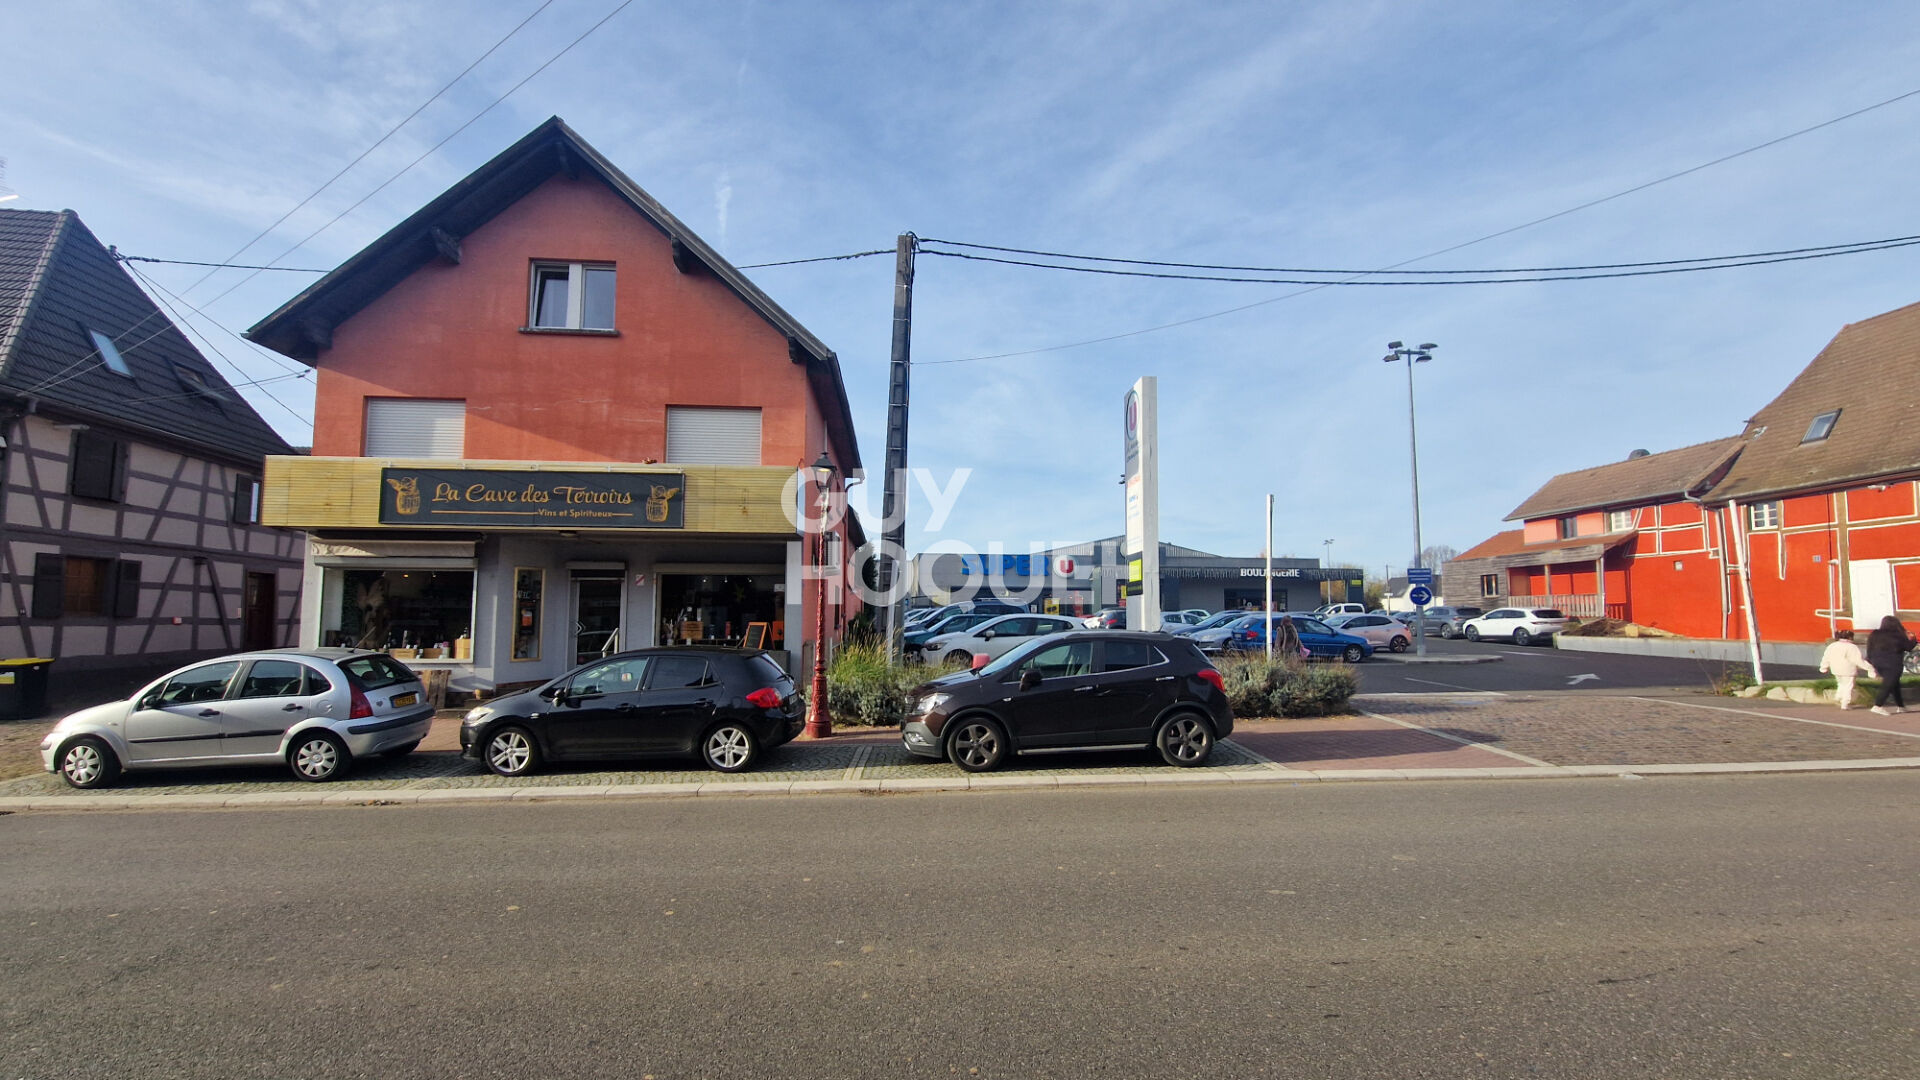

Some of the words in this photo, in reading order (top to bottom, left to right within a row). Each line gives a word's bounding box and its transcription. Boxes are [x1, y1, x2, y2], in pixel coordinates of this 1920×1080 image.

[432, 482, 460, 504] La
[465, 482, 517, 503] Cave
[521, 484, 551, 503] des
[553, 485, 633, 506] Terroirs
[538, 508, 557, 517] Vins
[559, 509, 568, 517] et
[570, 508, 613, 519] Spiritueux
[961, 553, 1050, 577] SUPER
[1060, 559, 1074, 574] U
